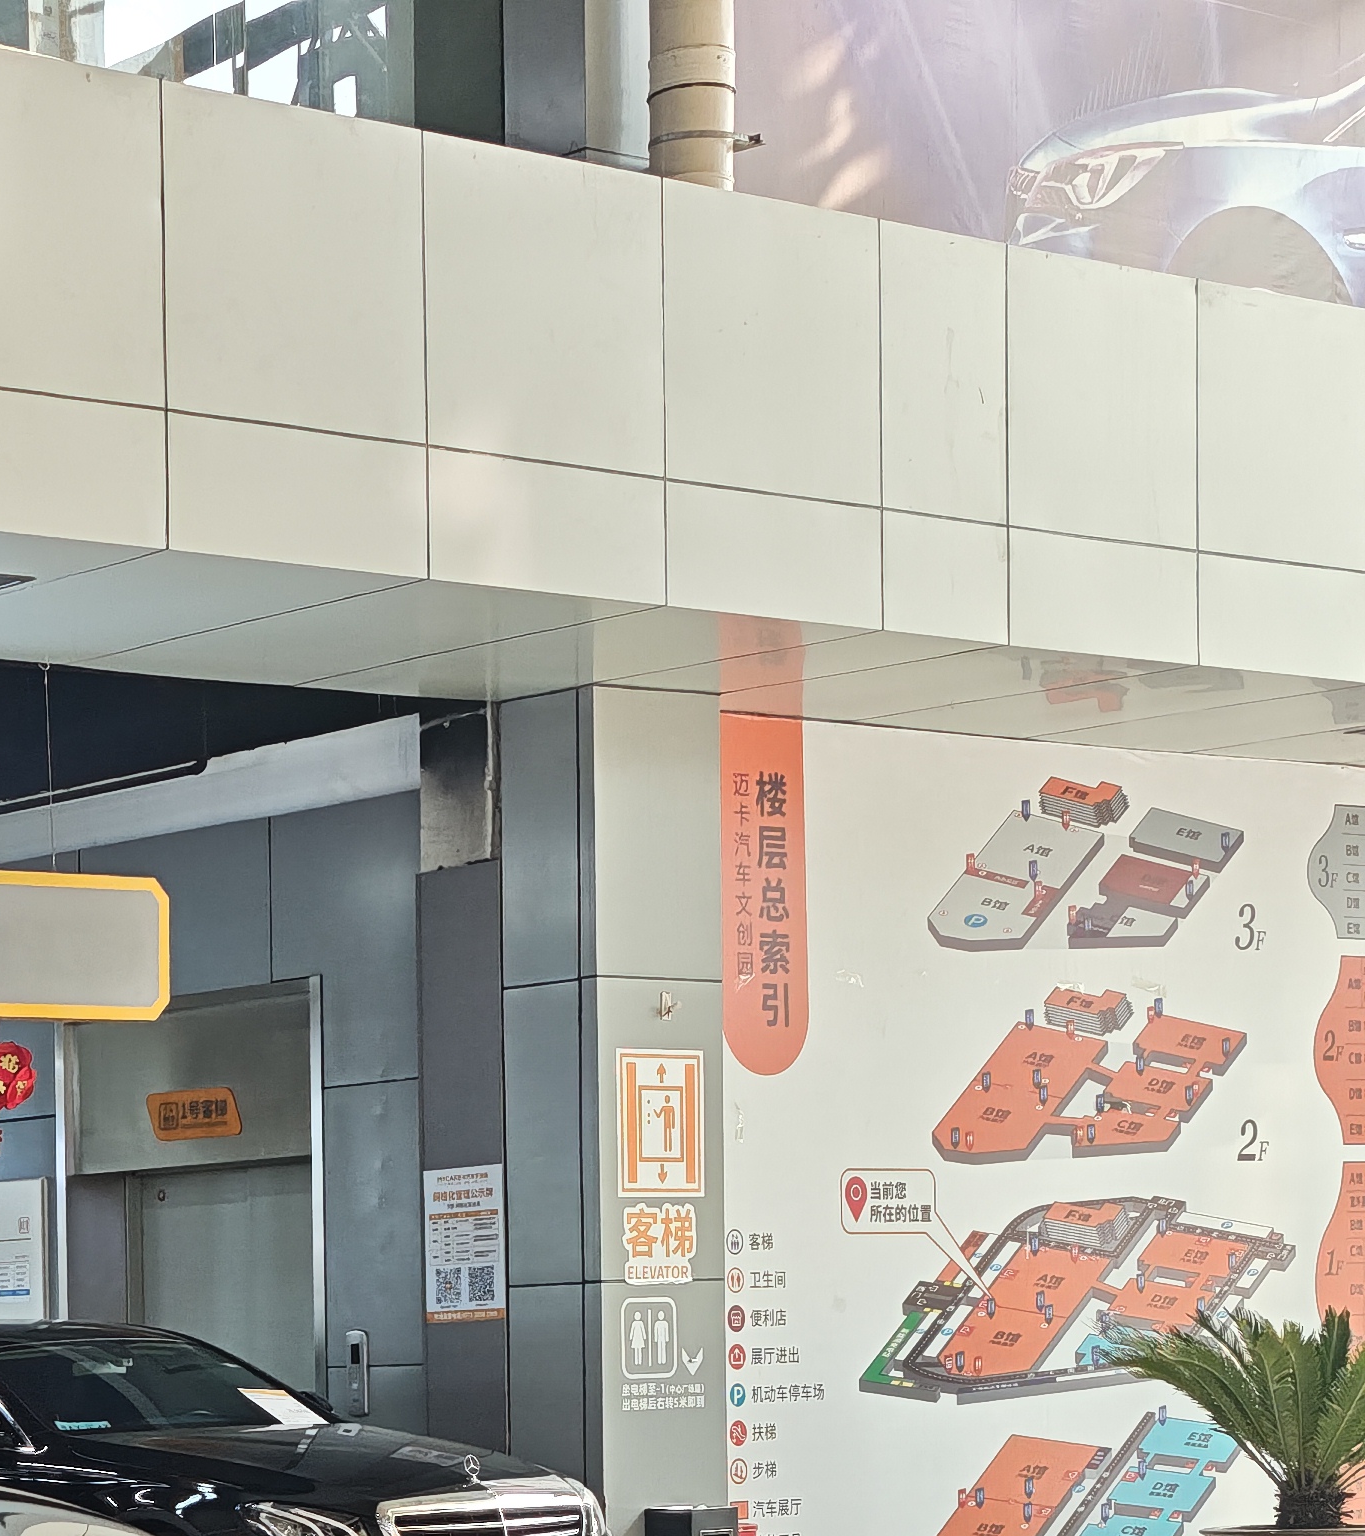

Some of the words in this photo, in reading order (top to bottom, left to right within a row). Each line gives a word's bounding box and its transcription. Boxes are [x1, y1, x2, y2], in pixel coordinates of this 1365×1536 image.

[1345, 813, 1359, 826] A馆
[1023, 843, 1054, 858] A馆
[1345, 844, 1360, 857] B馆
[732, 772, 756, 978] 迈卡汽车文创园
[1318, 855, 1338, 889] 3F
[756, 770, 791, 1028] 楼层总索引
[980, 897, 1010, 911] B馆
[1234, 903, 1267, 951] 3F
[1323, 1029, 1344, 1062] 2F
[1237, 1118, 1270, 1162] 2F
[870, 1181, 907, 1200] 当前您
[870, 1204, 933, 1223] 所在的位置
[625, 1207, 695, 1259] 客梯
[748, 1232, 774, 1251] 客梯
[627, 1265, 689, 1280] ELEVATOR
[749, 1270, 787, 1288] 卫生间
[750, 1308, 787, 1327] 便利店
[750, 1345, 800, 1366] 展厅进出
[751, 1383, 826, 1403] 机动车停车场
[752, 1422, 777, 1442] 扶梯
[753, 1461, 777, 1480] 步梯
[753, 1498, 803, 1518] 汽车展厅
